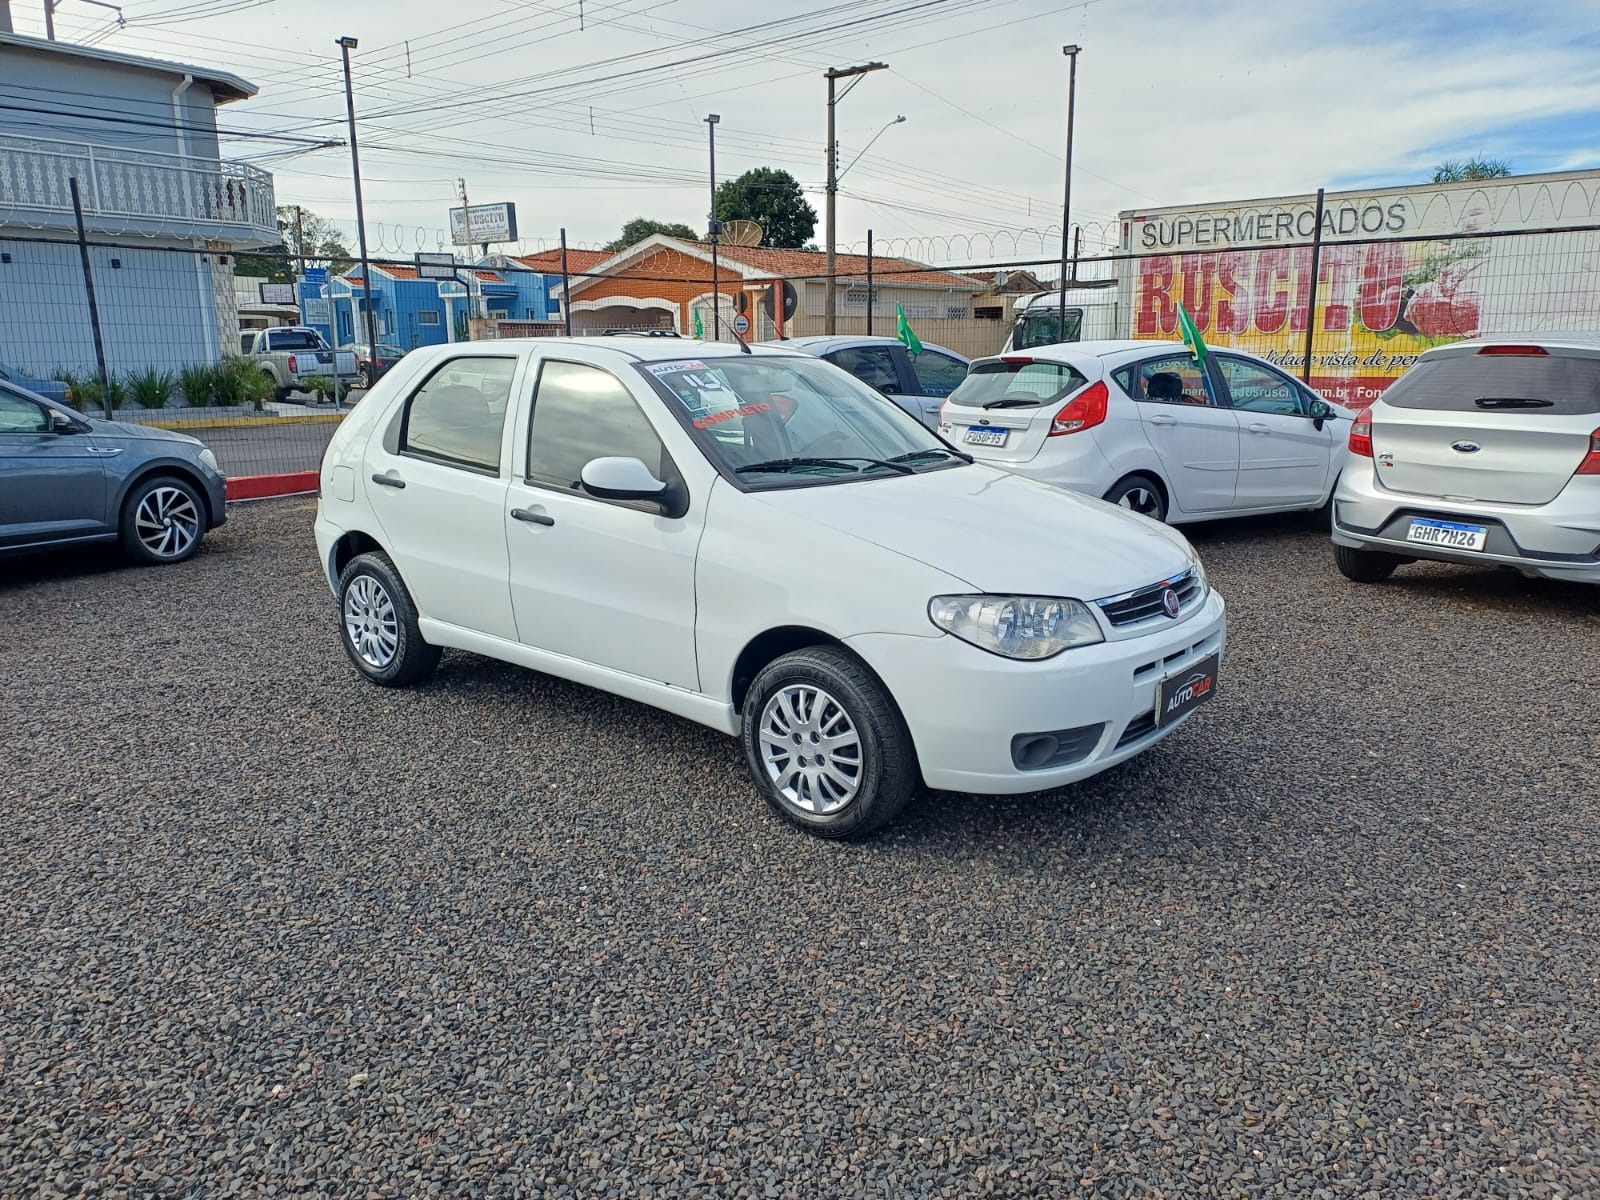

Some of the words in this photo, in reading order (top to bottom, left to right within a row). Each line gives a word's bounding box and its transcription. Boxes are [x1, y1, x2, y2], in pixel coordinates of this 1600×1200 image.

[1142, 204, 1406, 247] SUPERMERCADOS
[1137, 240, 1404, 335] RUSCITO
[1320, 351, 1358, 366] vista
[1362, 348, 1382, 366] de
[693, 402, 772, 430] COMPLETO
[1413, 525, 1476, 547] GHR7H26
[1166, 675, 1212, 713] AUTOCAR
